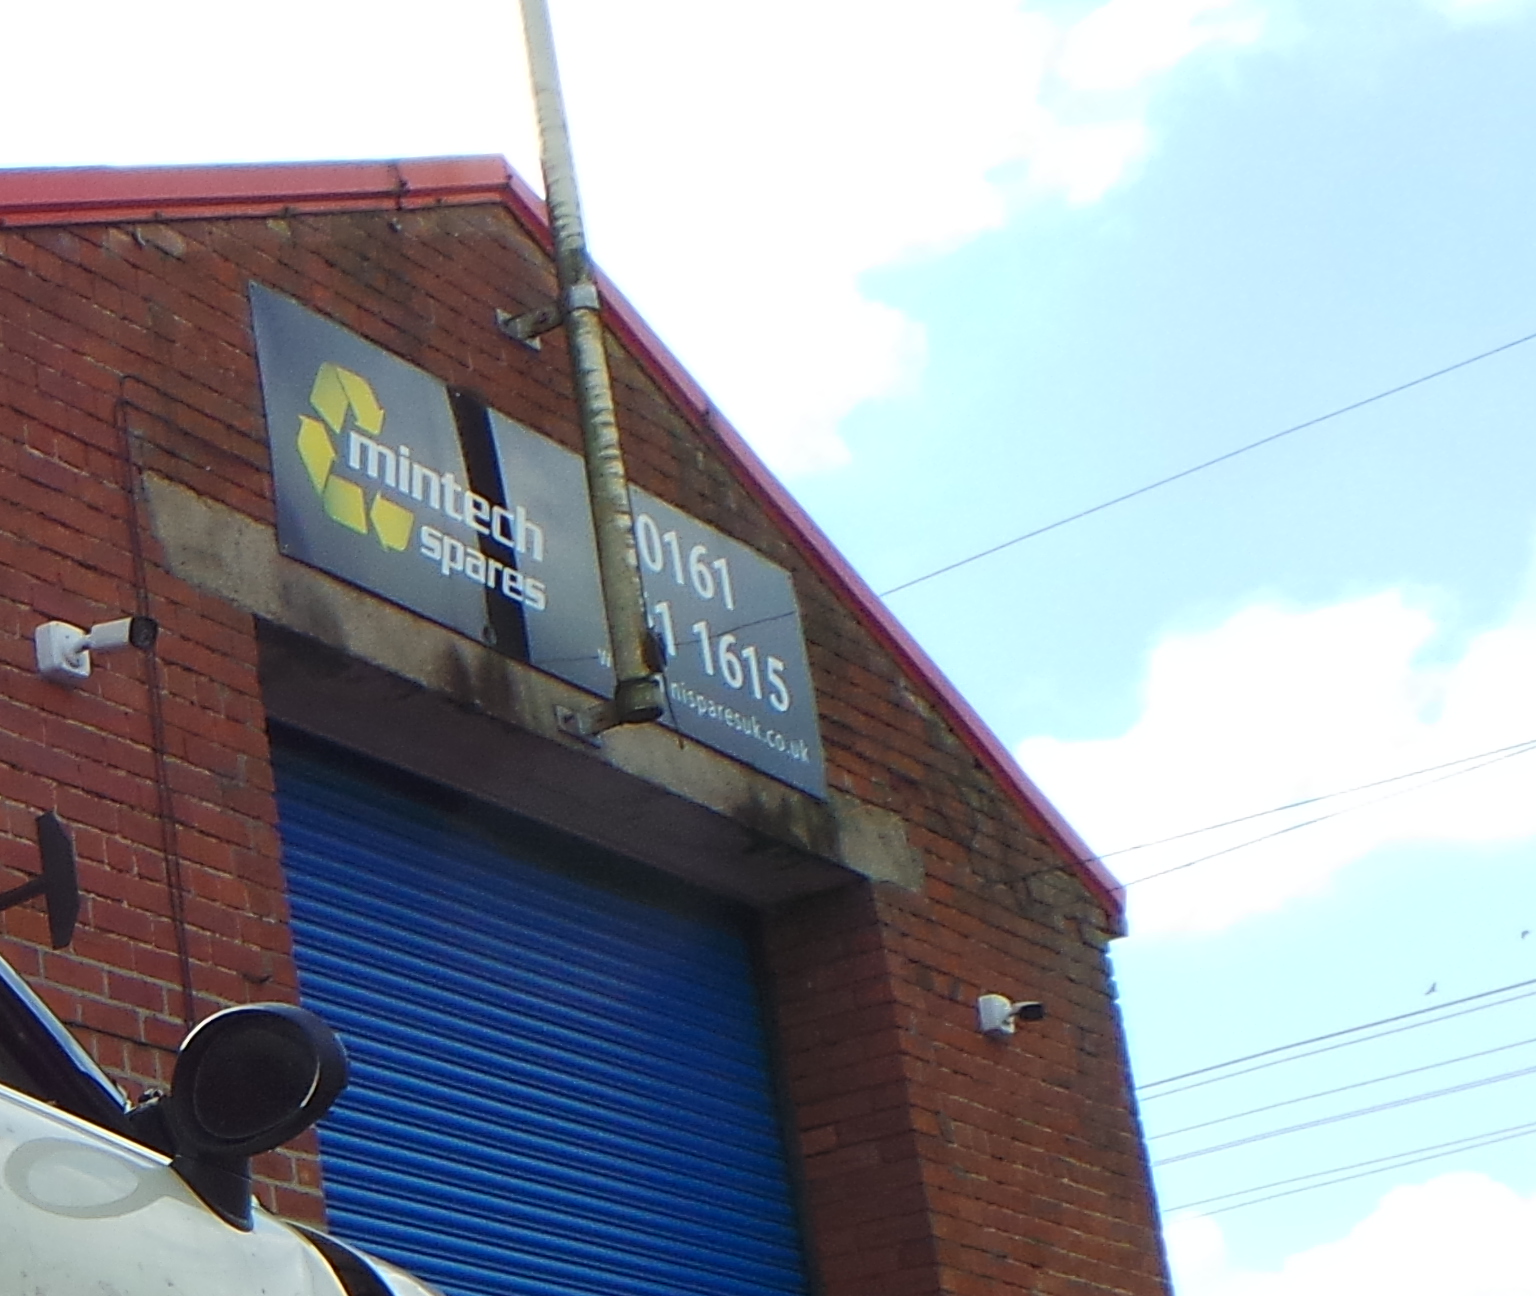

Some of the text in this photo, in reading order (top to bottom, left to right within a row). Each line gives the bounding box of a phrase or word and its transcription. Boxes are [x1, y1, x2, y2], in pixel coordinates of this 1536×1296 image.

[348, 430, 544, 562] mintech
[420, 524, 546, 611] spares
[636, 513, 734, 610] 0161
[692, 620, 790, 712] 1615
